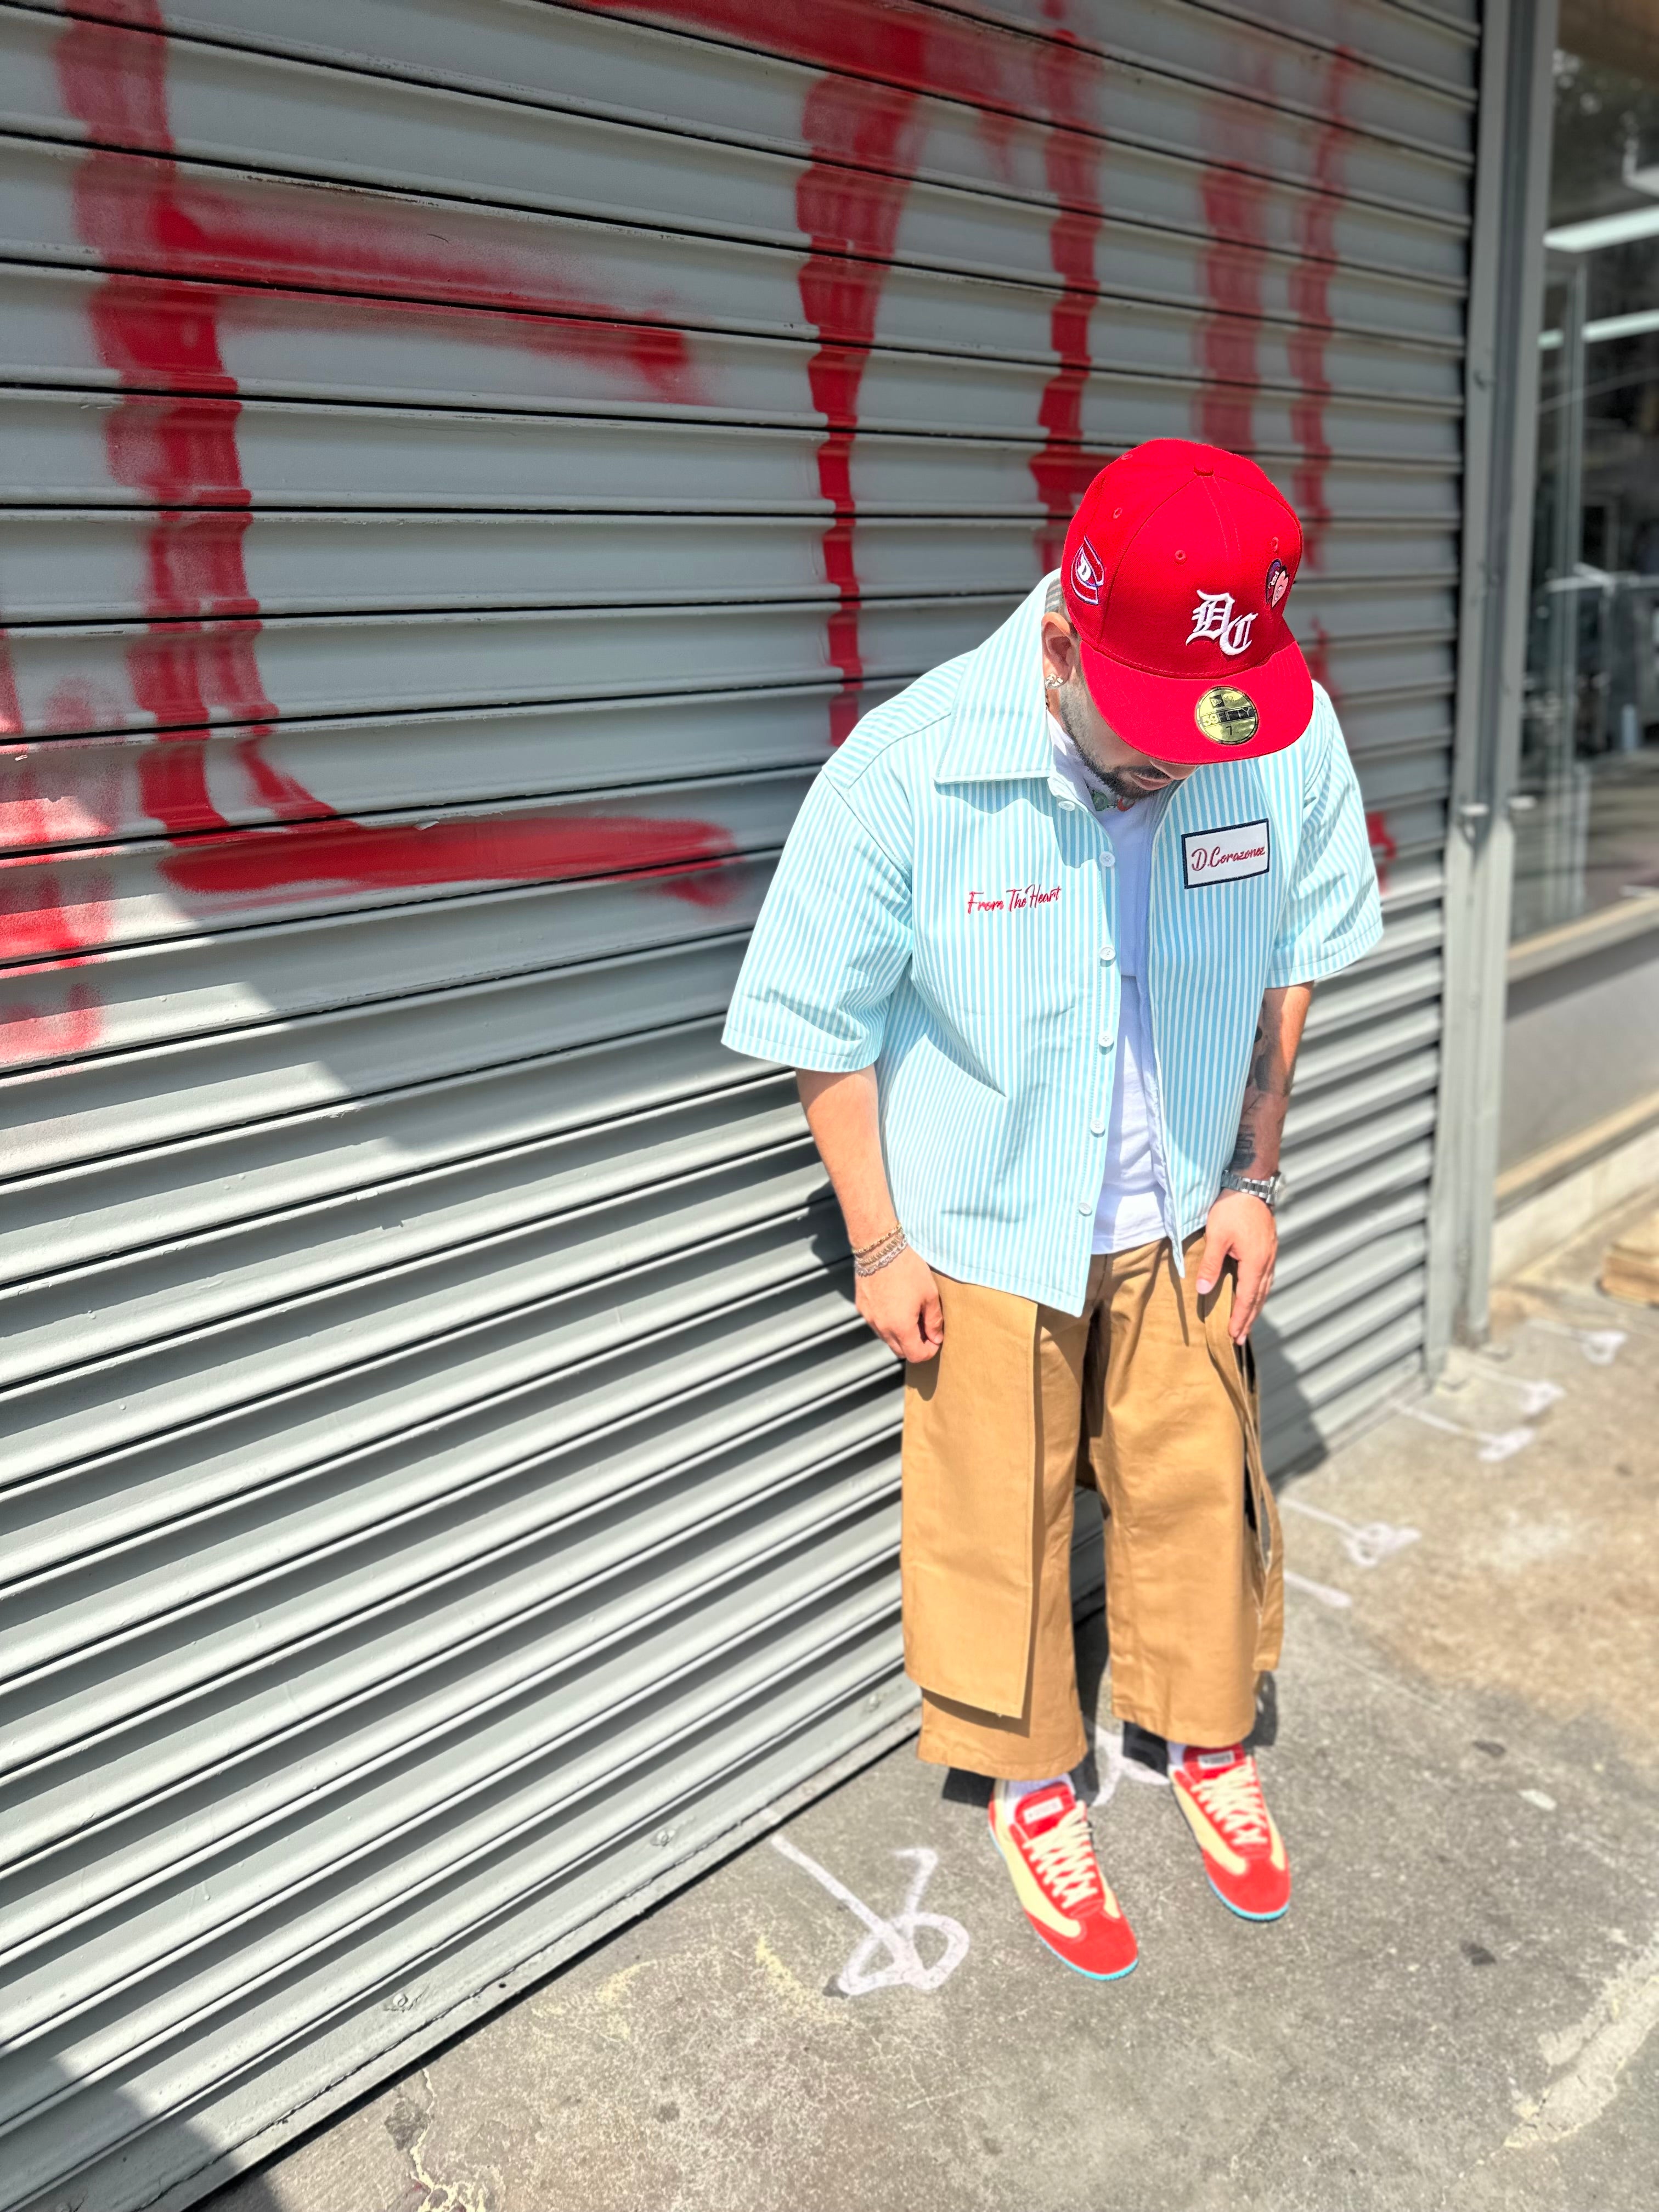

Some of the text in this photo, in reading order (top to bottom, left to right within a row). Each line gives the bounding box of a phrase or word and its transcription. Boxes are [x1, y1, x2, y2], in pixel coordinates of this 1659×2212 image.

[1185, 589, 1259, 656] DC
[1226, 726, 1233, 736] 7
[967, 884, 1062, 915] From The Heart
